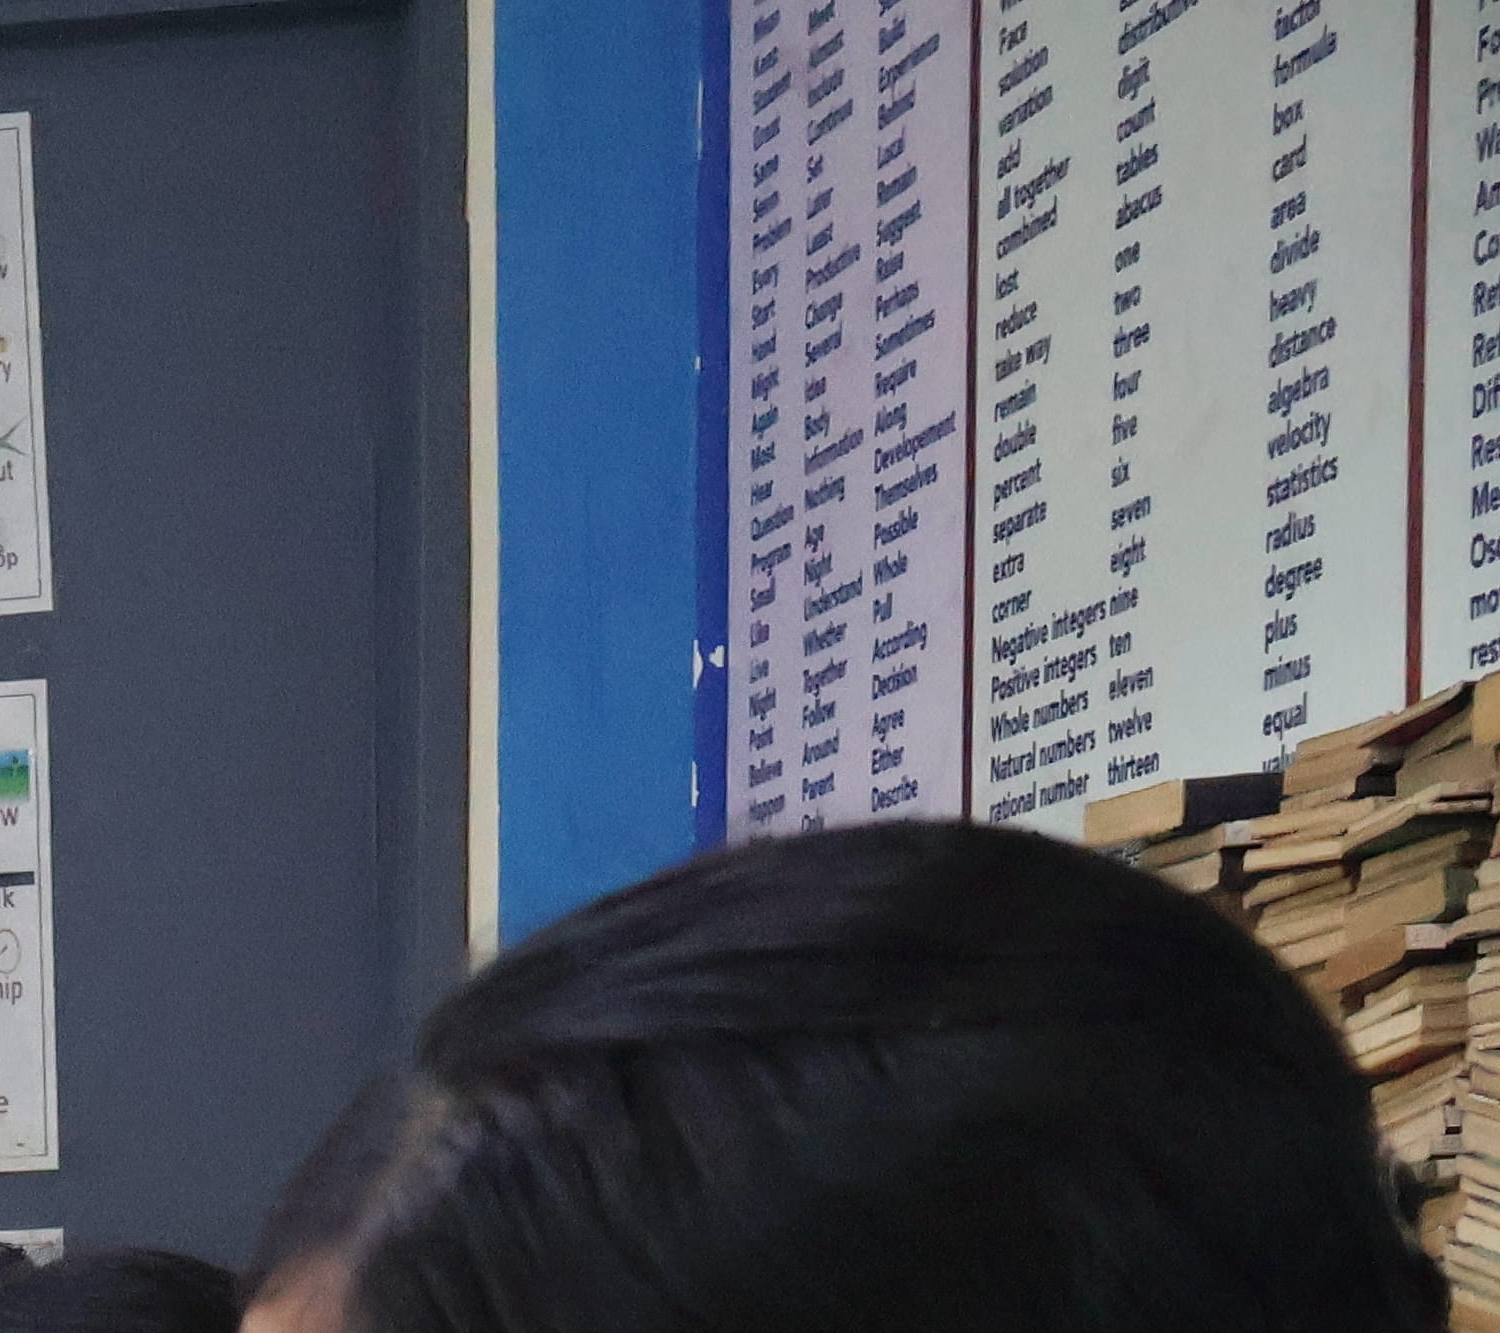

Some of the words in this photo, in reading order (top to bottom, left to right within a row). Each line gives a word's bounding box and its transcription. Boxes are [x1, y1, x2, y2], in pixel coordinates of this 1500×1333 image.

[1114, 323, 1150, 358] three
[1114, 369, 1142, 401] four
[1267, 366, 1329, 418] algebra
[994, 420, 1036, 462] double
[1112, 414, 1138, 445] five
[1267, 411, 1331, 459] velocity
[994, 458, 1042, 512] percent
[1111, 456, 1130, 488] six
[1267, 455, 1339, 507] statistics
[992, 501, 1047, 545] separate
[1111, 496, 1151, 530] seven
[1266, 512, 1316, 553] radius
[993, 551, 1025, 583] extra
[1111, 534, 1146, 578] eight
[1265, 557, 1323, 601] degree
[991, 589, 1032, 623] corner
[1109, 586, 1139, 617] nine
[991, 622, 1048, 665] Negative
[1051, 598, 1106, 640] integers
[1109, 630, 1132, 658] ten
[1264, 609, 1298, 654] plus
[991, 665, 1040, 703] Positive
[1044, 643, 1097, 683] integers
[1109, 666, 1153, 700] eleven
[1263, 654, 1311, 691] minus
[990, 706, 1029, 743] Whole
[1033, 688, 1089, 729] numbers
[1108, 706, 1153, 744] twelve
[1262, 691, 1308, 741] equal
[990, 742, 1036, 783] Natural
[1039, 729, 1096, 767] numbers
[1107, 750, 1160, 786] thirteen
[1039, 769, 1090, 807] number
